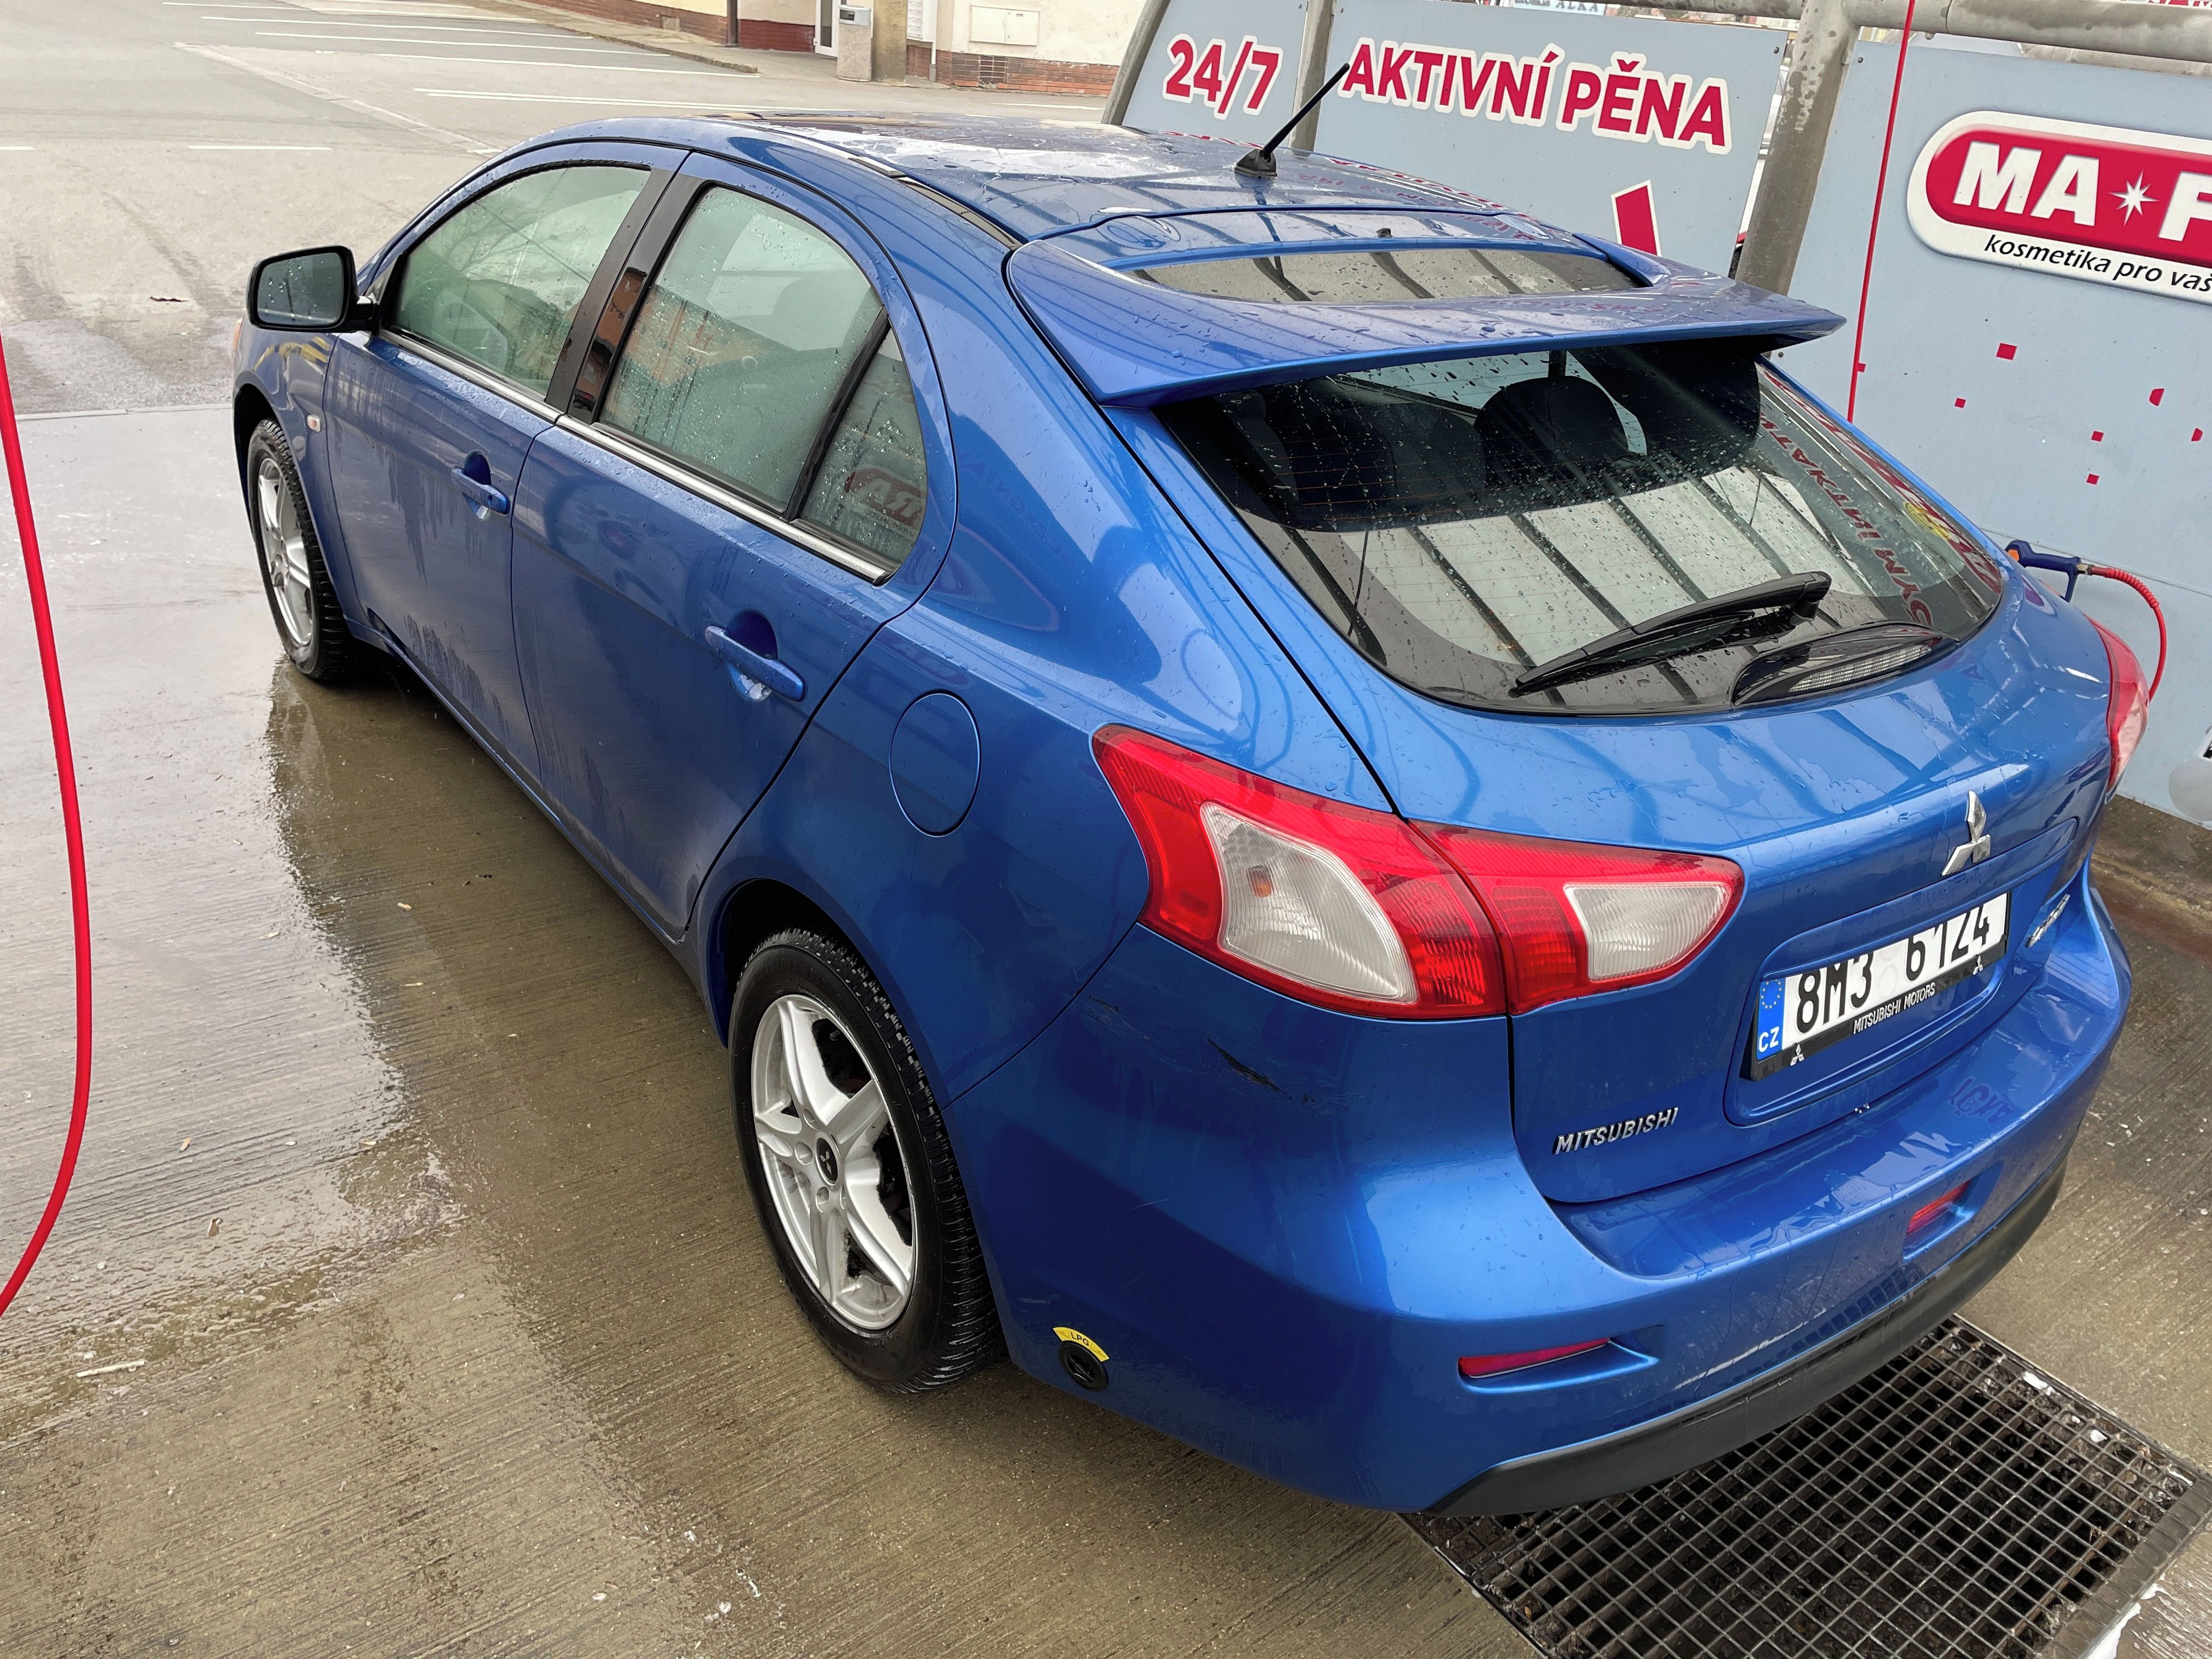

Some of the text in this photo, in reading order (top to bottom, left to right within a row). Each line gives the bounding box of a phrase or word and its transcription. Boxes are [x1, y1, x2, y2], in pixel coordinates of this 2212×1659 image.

[1166, 39, 1279, 114] 24/7
[1342, 43, 1726, 148] AKTIVNÍ PĚNA
[1984, 234, 2112, 273] kosmetika
[2112, 261, 2163, 281] pro
[1796, 950, 1875, 1035] 8M3
[1853, 983, 1936, 1035] MITSUBISHI MOTORS
[1758, 1025, 1780, 1053] CZ
[1553, 1105, 1679, 1155] MITSUBISHI
[1070, 1331, 1090, 1347] LPG
